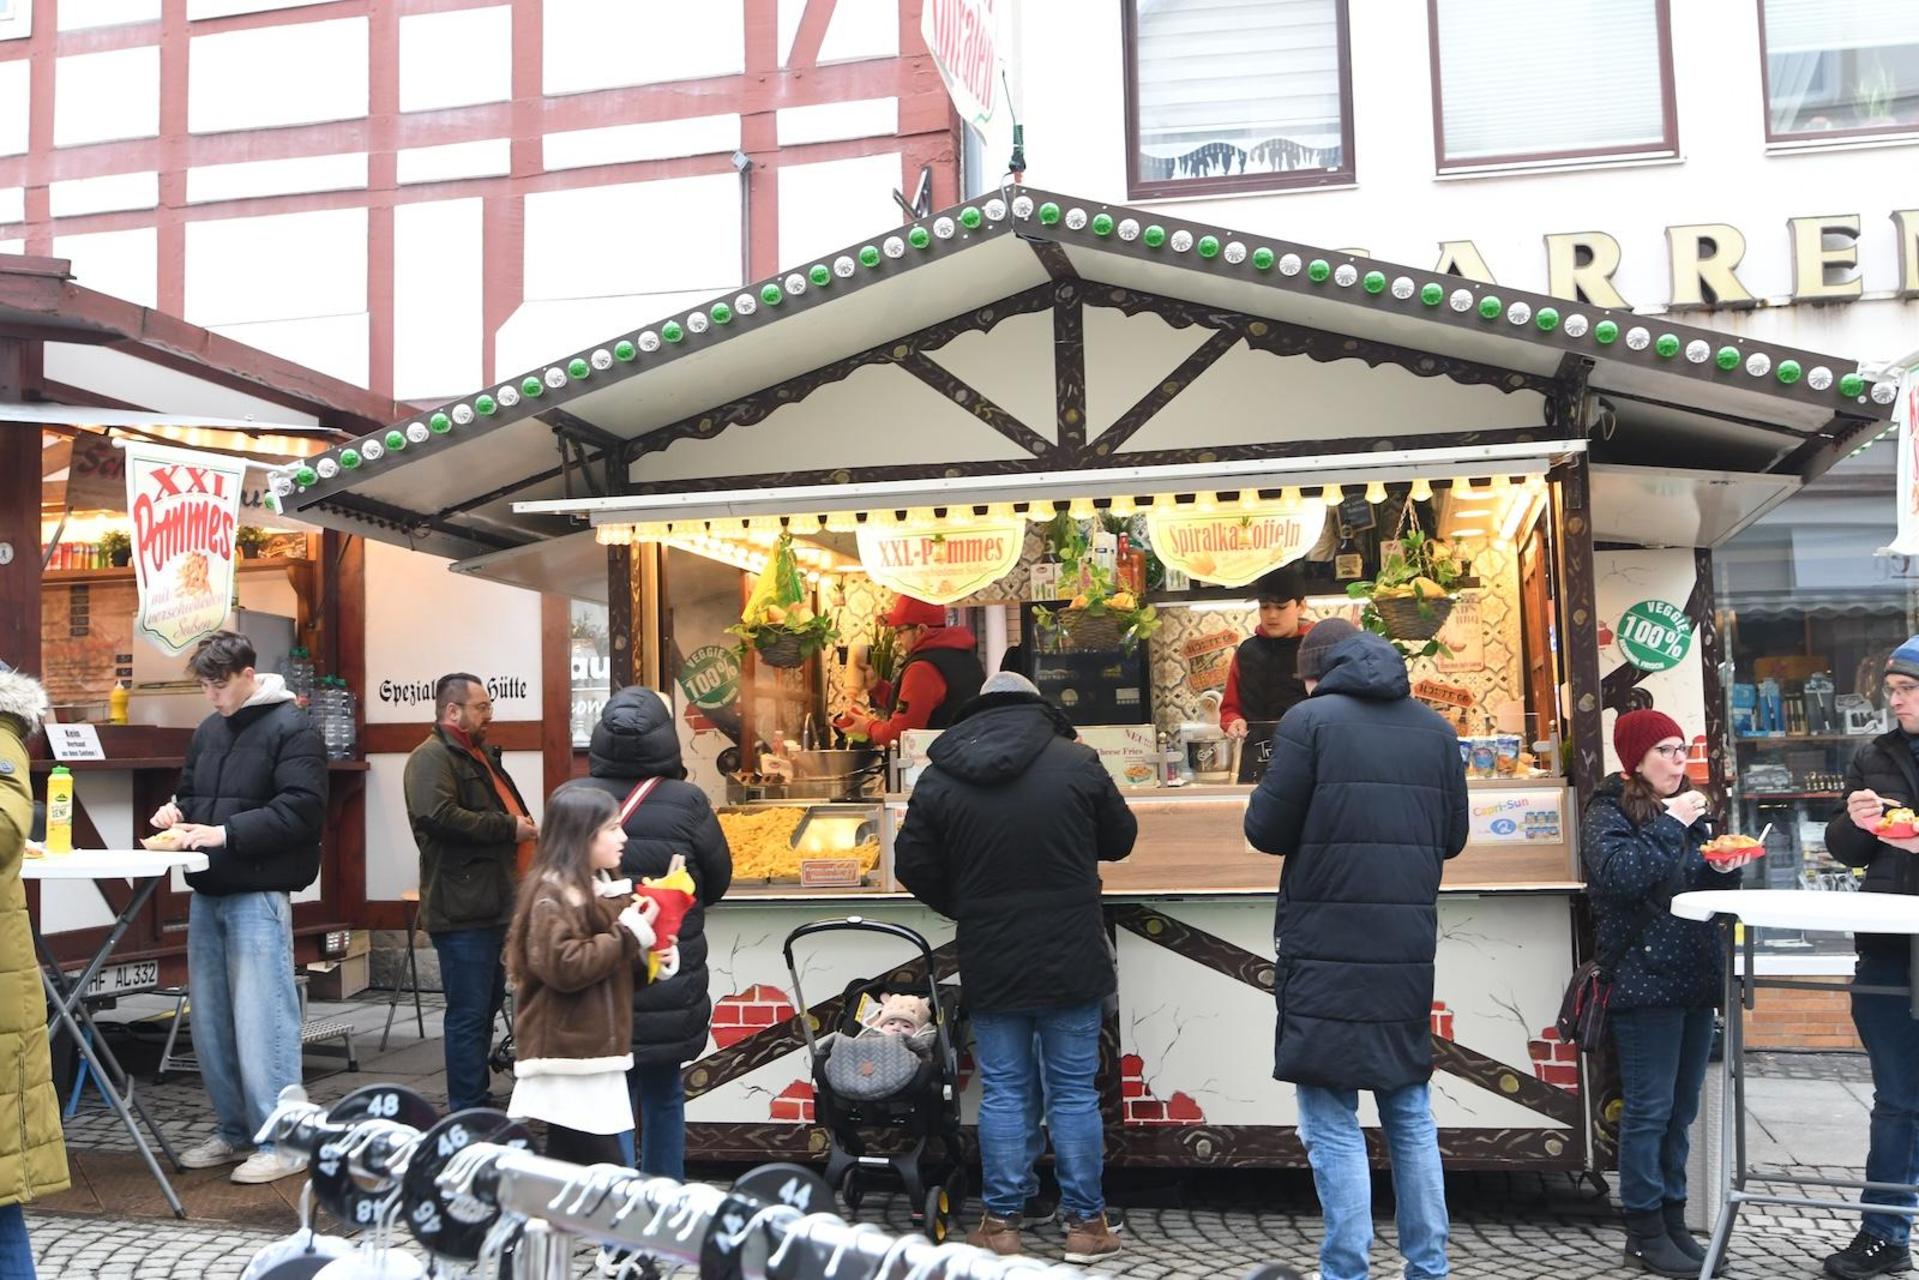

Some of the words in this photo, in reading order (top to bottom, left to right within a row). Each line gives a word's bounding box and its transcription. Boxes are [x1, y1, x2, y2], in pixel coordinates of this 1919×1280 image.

[1336, 209, 1919, 313] ARRE
[150, 464, 228, 503] XXL
[134, 492, 234, 589] Pommes
[878, 535, 1005, 568] XXL-Pmmes
[1169, 518, 1301, 557] Spiralkaoffeln
[1647, 601, 1689, 634] VEGGIE
[1623, 615, 1683, 658] 100%
[686, 647, 725, 668] VEGGIE
[379, 680, 437, 706] Spezial
[686, 659, 738, 699] 100%
[1473, 798, 1530, 818] Capri-Sun
[366, 1093, 399, 1117] 48
[437, 1123, 470, 1158] 46
[778, 1177, 813, 1214] 44
